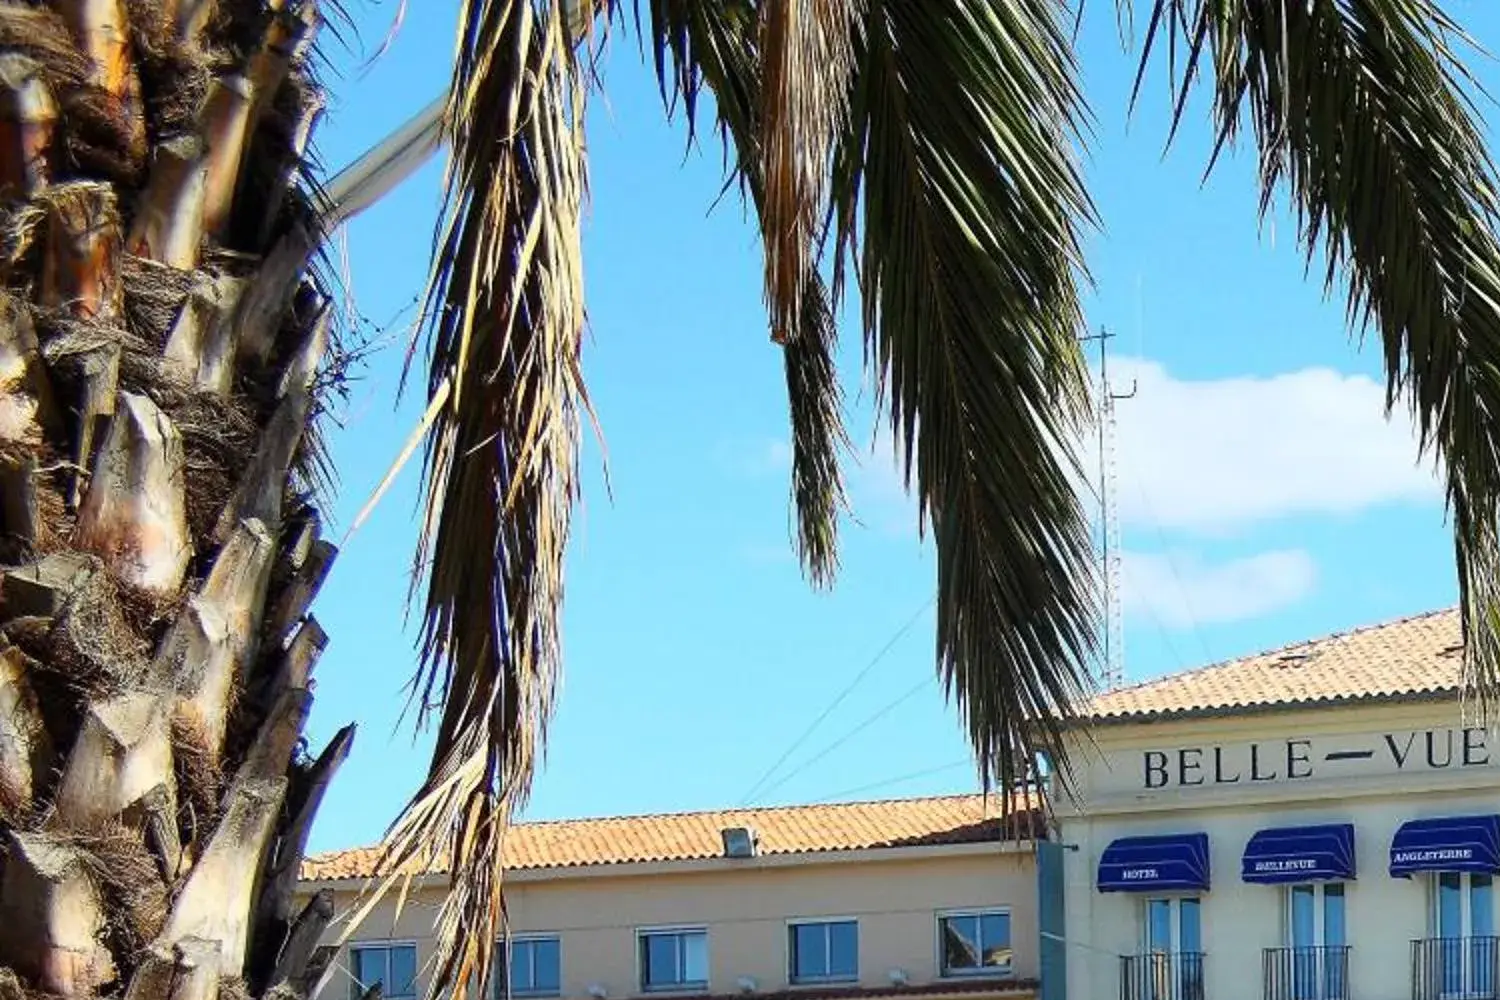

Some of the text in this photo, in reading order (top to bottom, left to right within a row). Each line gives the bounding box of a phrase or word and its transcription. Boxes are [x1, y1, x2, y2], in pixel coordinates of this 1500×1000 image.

[1394, 848, 1473, 863] ANGLETERRE
[1255, 858, 1317, 872] BELLEVUE
[1122, 868, 1159, 880] HOTEL
